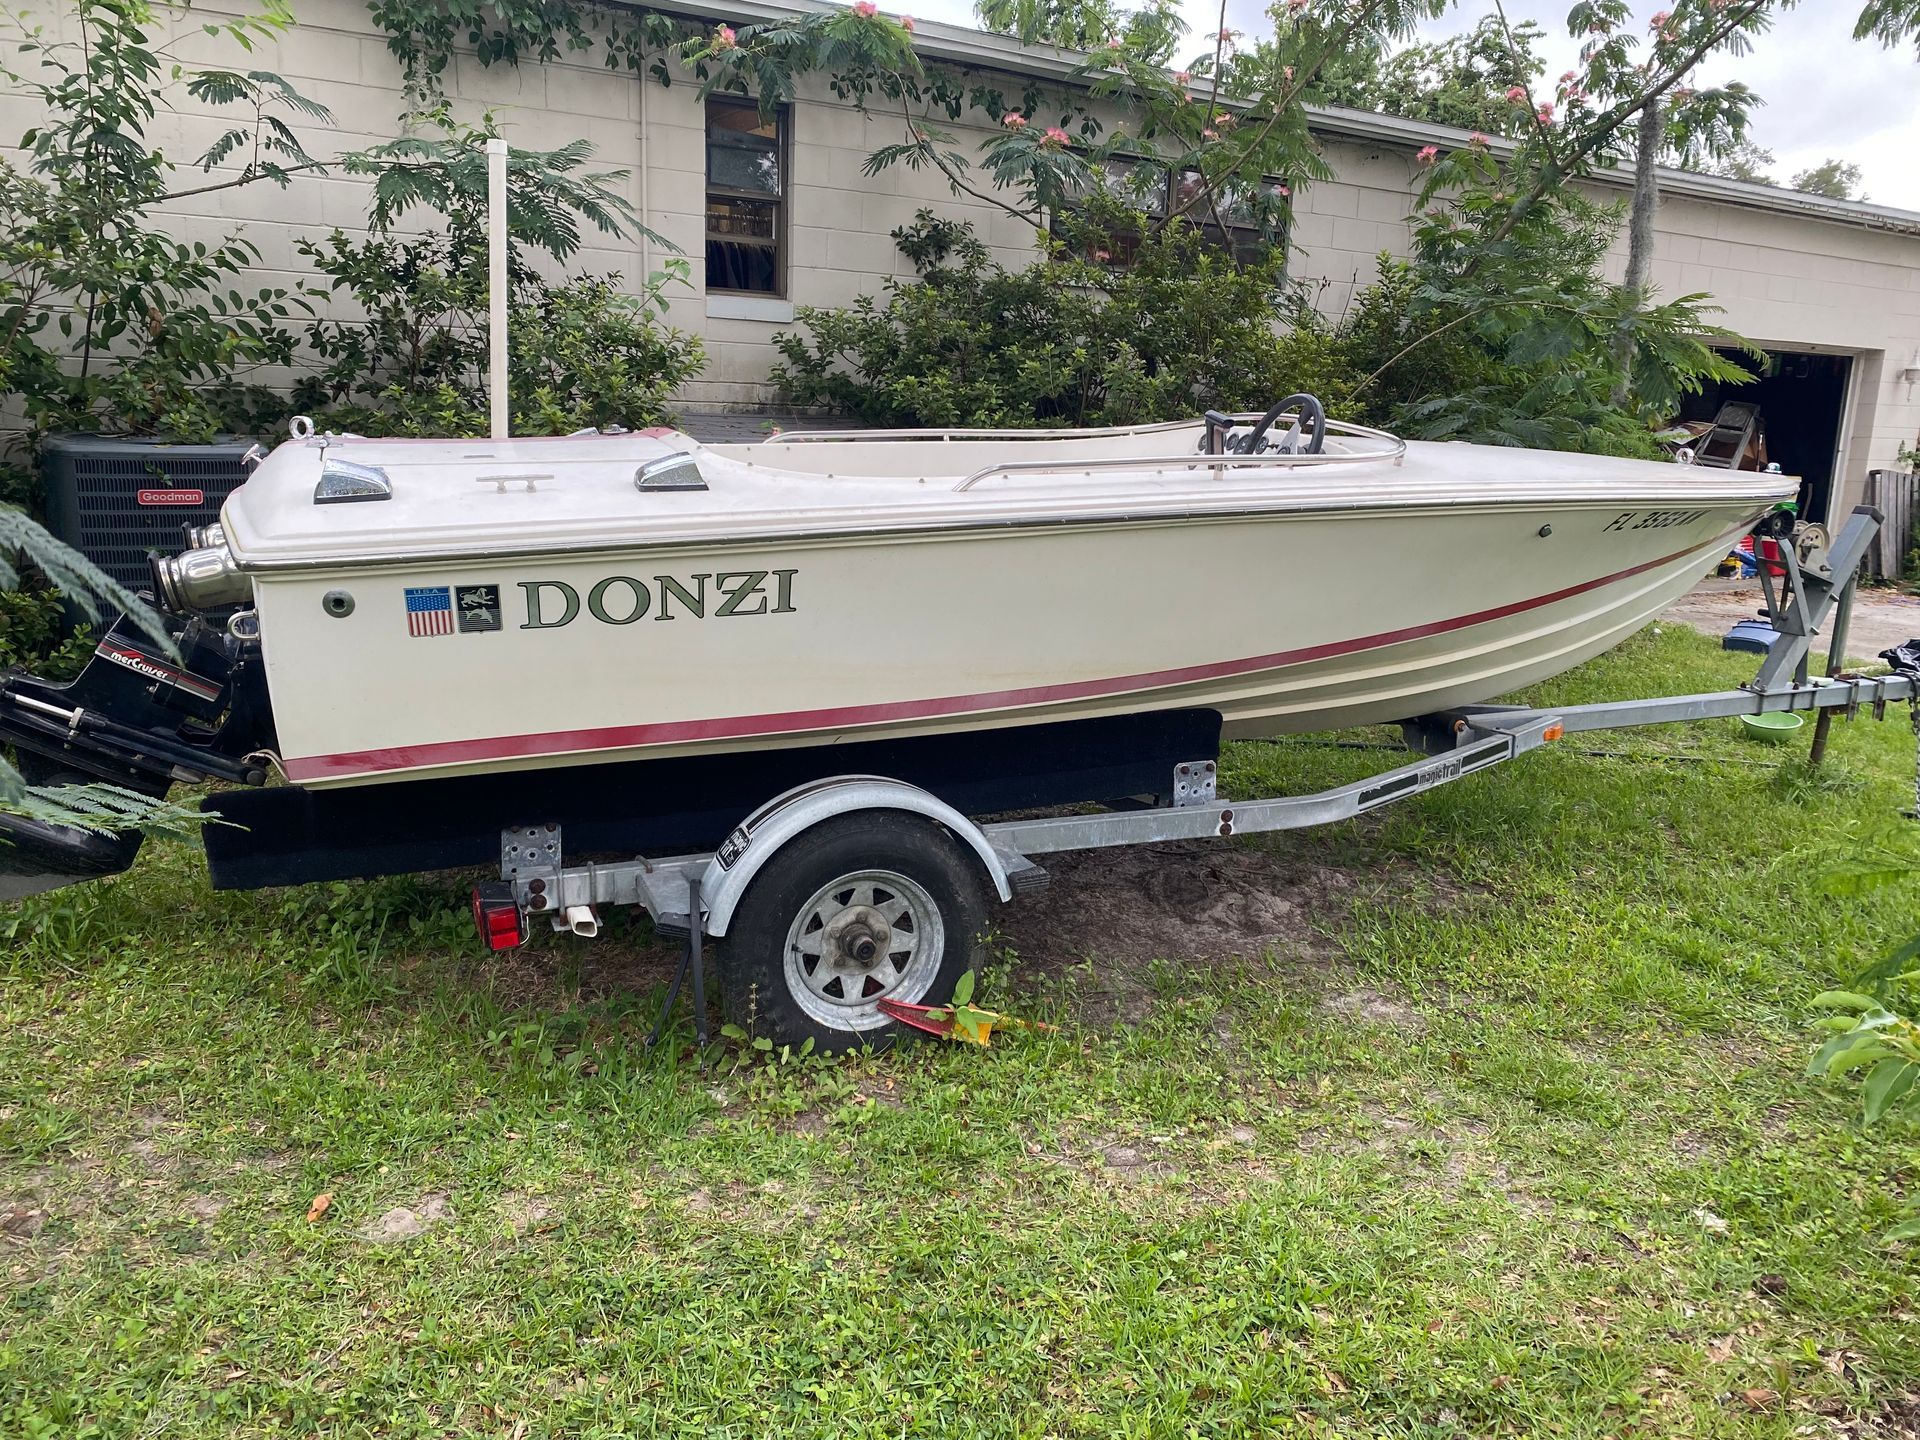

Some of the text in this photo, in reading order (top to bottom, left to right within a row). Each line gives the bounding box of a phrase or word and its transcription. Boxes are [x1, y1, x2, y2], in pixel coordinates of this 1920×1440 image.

[142, 492, 199, 501] Goodman
[1602, 512, 1638, 532] FL
[517, 569, 799, 629] DONZI
